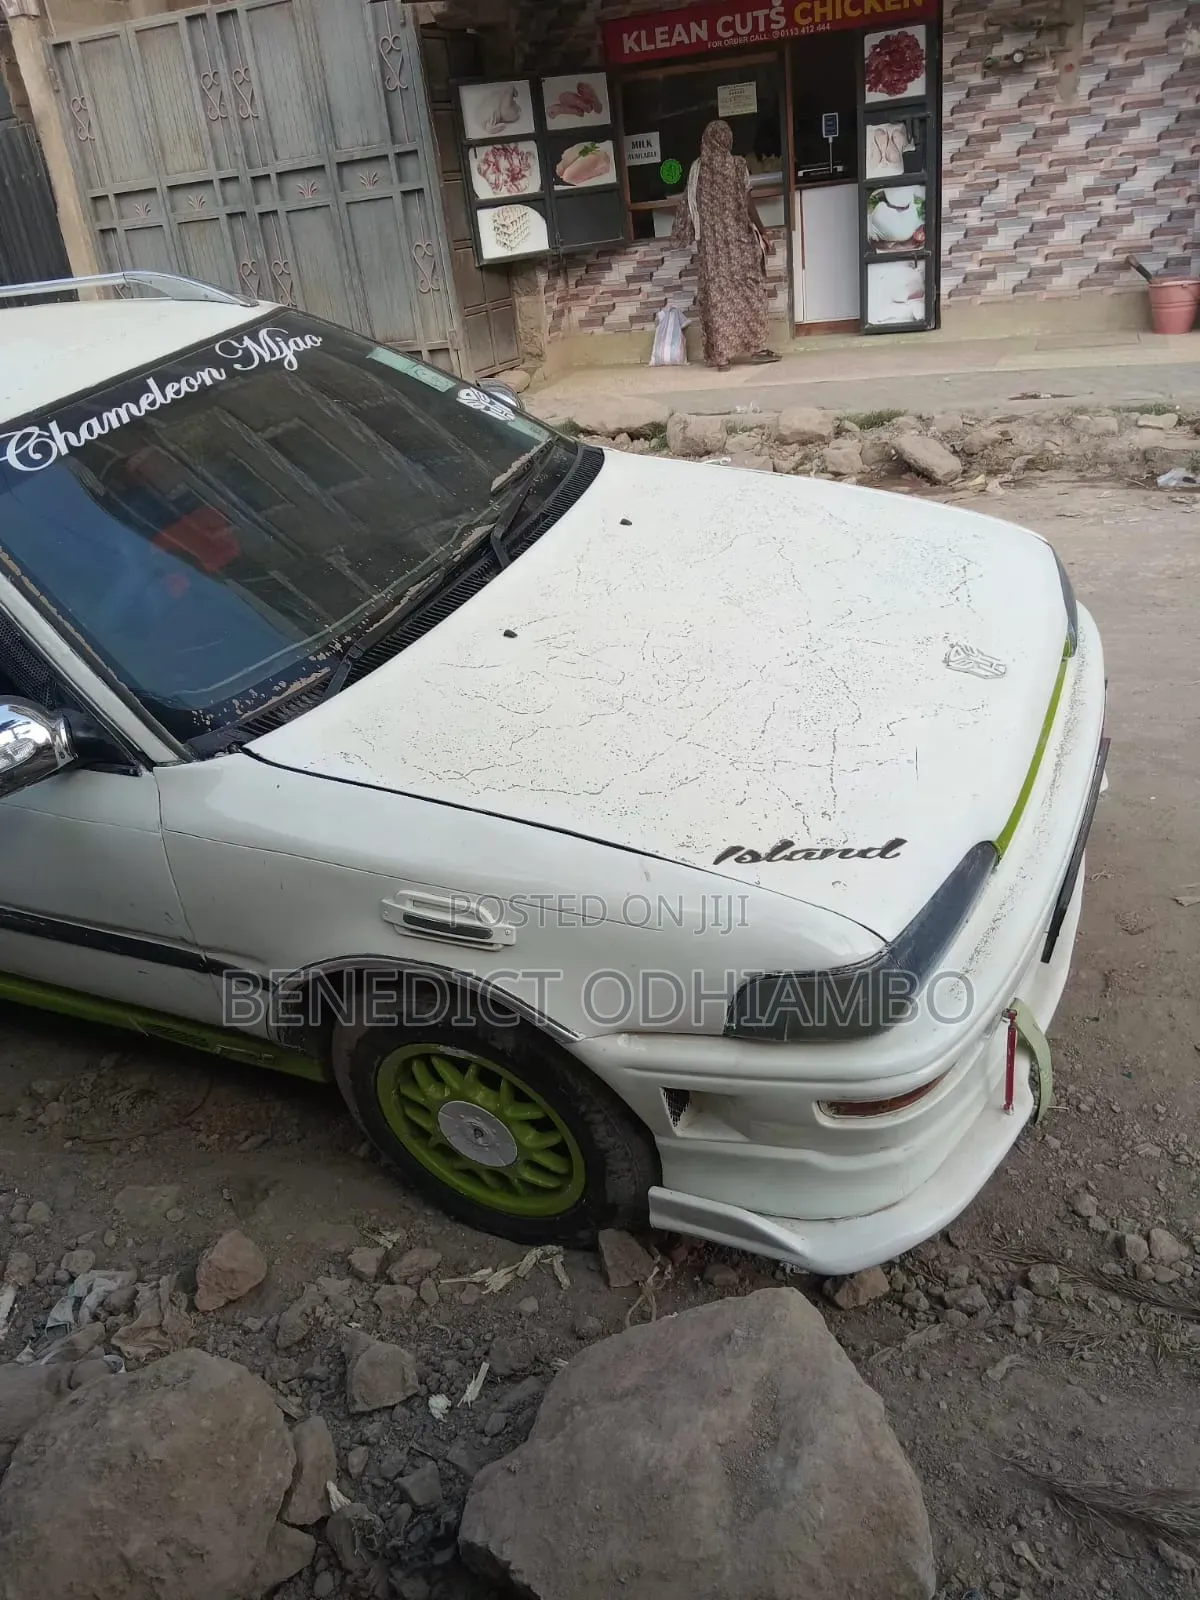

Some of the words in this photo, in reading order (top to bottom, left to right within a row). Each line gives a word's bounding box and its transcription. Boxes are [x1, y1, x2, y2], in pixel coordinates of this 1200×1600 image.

[623, 19, 708, 54] KLEAN
[716, 6, 787, 38] CUTS
[708, 40, 722, 49] FOR
[723, 36, 749, 47] ORDER
[631, 139, 653, 150] MILK
[0, 365, 227, 472] Chameleon
[712, 837, 908, 866] Island
